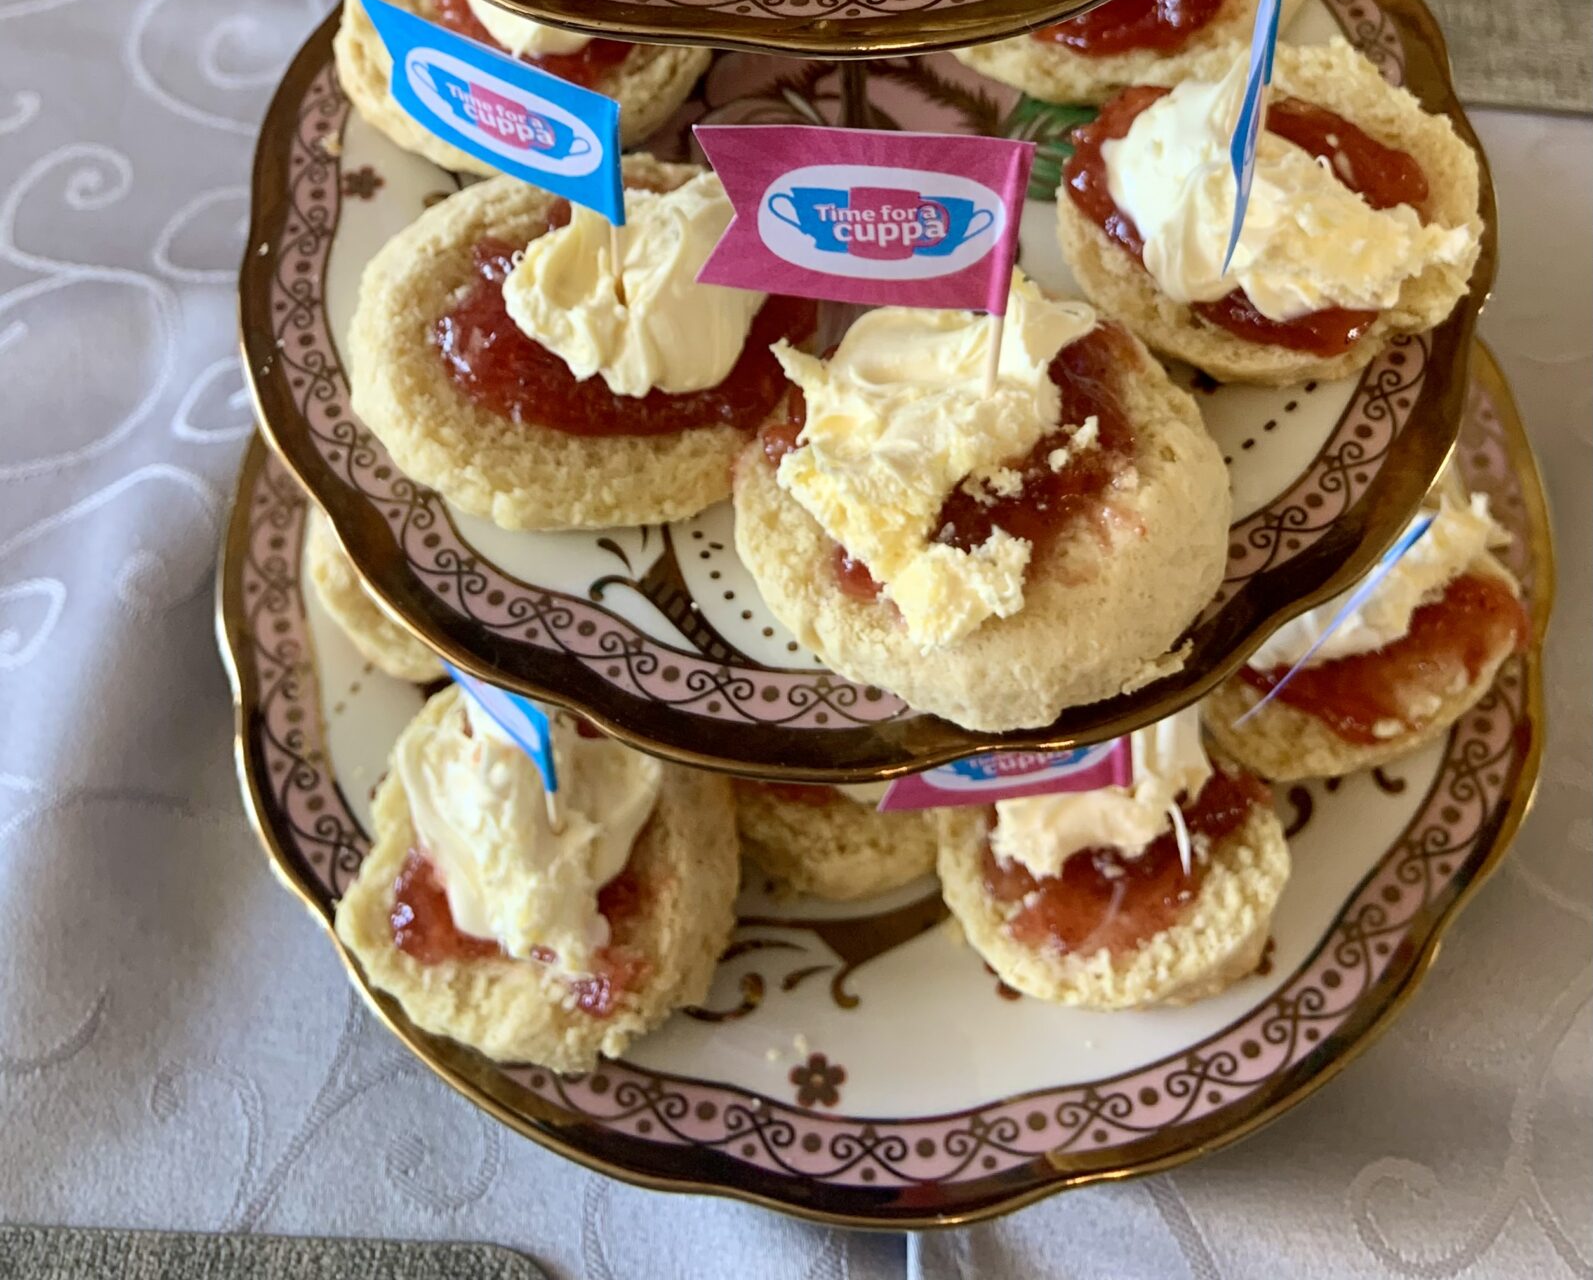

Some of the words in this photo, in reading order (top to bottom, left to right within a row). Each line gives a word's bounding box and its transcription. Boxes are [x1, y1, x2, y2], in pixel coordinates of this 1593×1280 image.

[445, 82, 493, 113] Time
[495, 104, 527, 123] for
[531, 117, 545, 130] a
[463, 102, 556, 146] cuppa
[813, 203, 876, 222] Time
[879, 205, 917, 221] for
[922, 205, 937, 219] a
[832, 220, 947, 248] cuppa
